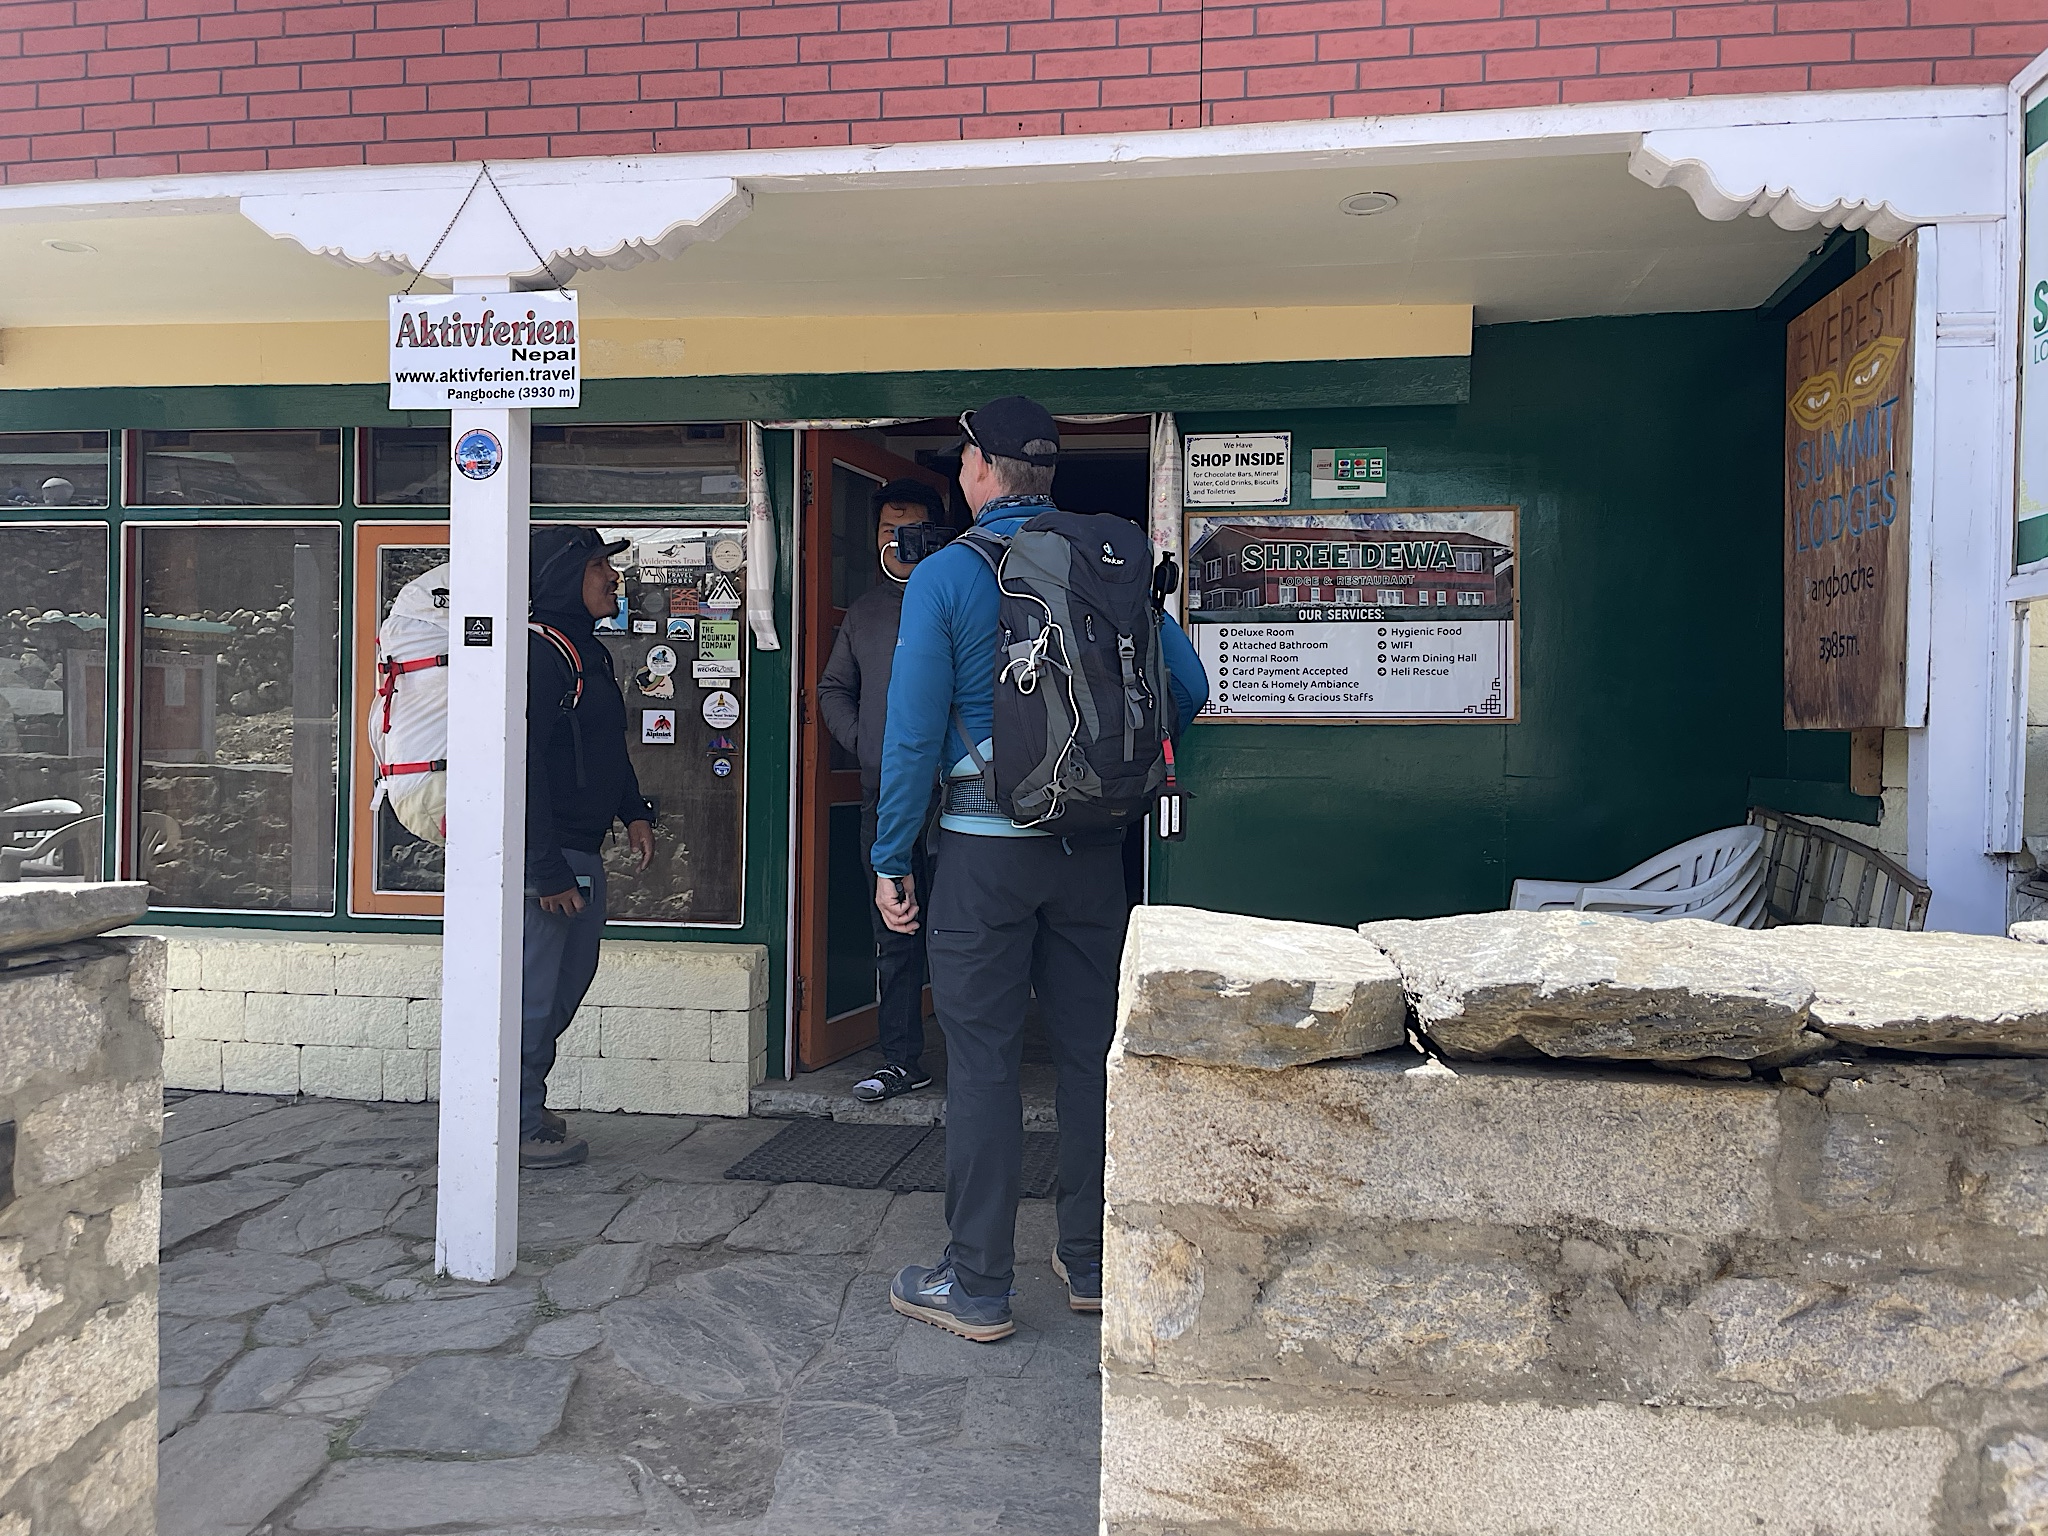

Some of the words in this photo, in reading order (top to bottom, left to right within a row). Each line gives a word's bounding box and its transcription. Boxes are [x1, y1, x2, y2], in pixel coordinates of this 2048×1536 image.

[395, 310, 576, 347] Aktivferien
[1795, 268, 1902, 383] EVEREST
[511, 347, 576, 364] Nepal
[395, 366, 575, 383] www.aktivferien.travel
[447, 387, 515, 401] Pangboche
[518, 387, 555, 400] (3930
[559, 387, 575, 399] m)
[1796, 396, 1899, 489] SUMMIT
[1191, 453, 1231, 467] SHOP
[1235, 452, 1285, 466] INSIDE
[1204, 470, 1236, 478] Chocolate
[1237, 470, 1253, 478] Bars,
[1230, 479, 1253, 487] Drinks,
[1796, 469, 1898, 553] LODGES
[640, 557, 682, 565] Wilderness
[683, 556, 705, 565] Travel
[1241, 543, 1350, 571] SHREE
[1358, 540, 1456, 570] DEWA
[1279, 576, 1320, 587] LODGE
[1323, 576, 1333, 586] &
[1335, 574, 1415, 586] RESTAURANT
[1298, 609, 1323, 621] OUR
[1327, 608, 1385, 621] SERVICES:
[1230, 628, 1264, 637] Deluxe
[1266, 628, 1294, 636] Room
[1391, 627, 1435, 638] Hygienic
[1437, 627, 1462, 636] Food
[1232, 641, 1277, 649] Attached
[1279, 641, 1328, 649] Bathroom
[1390, 641, 1413, 649] WIFI
[1232, 654, 1268, 662] Normal
[1270, 654, 1299, 662] Room
[1390, 654, 1420, 662] Warm
[1422, 653, 1455, 664] Dining
[1457, 653, 1477, 662] Hall
[1232, 667, 1255, 676] Card
[1257, 667, 1300, 677] Payment
[1302, 667, 1348, 676] Accepted
[1391, 667, 1410, 675] Heli
[1413, 667, 1449, 675] Rescue
[1232, 680, 1259, 689] Clean
[1261, 680, 1269, 688] &
[1271, 680, 1308, 691] Homely
[1310, 679, 1360, 688] Ambiance
[1232, 693, 1286, 703] Welcoming
[1287, 693, 1295, 701] &
[1297, 693, 1341, 702] Gracious
[1343, 692, 1374, 701] Staffs
[645, 731, 671, 739] Alpinist
